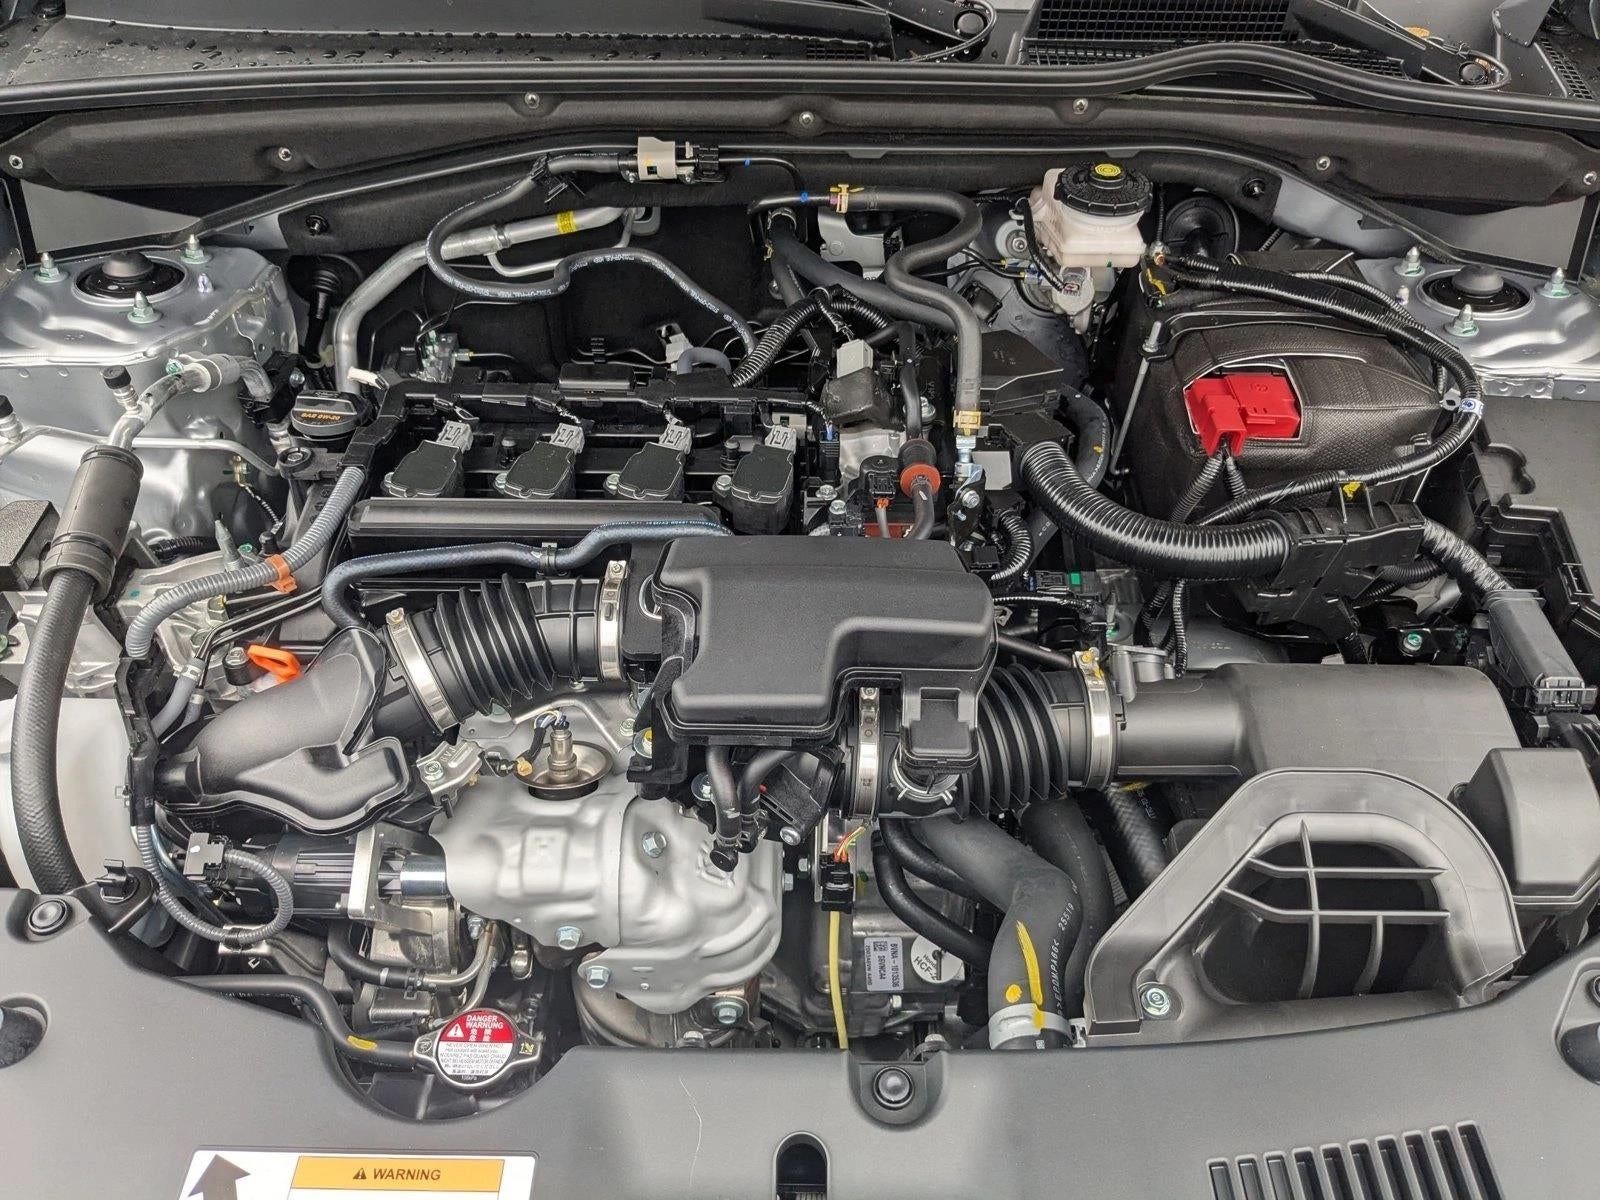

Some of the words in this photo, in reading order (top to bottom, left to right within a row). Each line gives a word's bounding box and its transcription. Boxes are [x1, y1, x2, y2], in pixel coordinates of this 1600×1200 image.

[466, 1015, 498, 1023] DANGER
[466, 1021, 504, 1030] WARNUNG
[373, 1168, 441, 1181] WARNING
